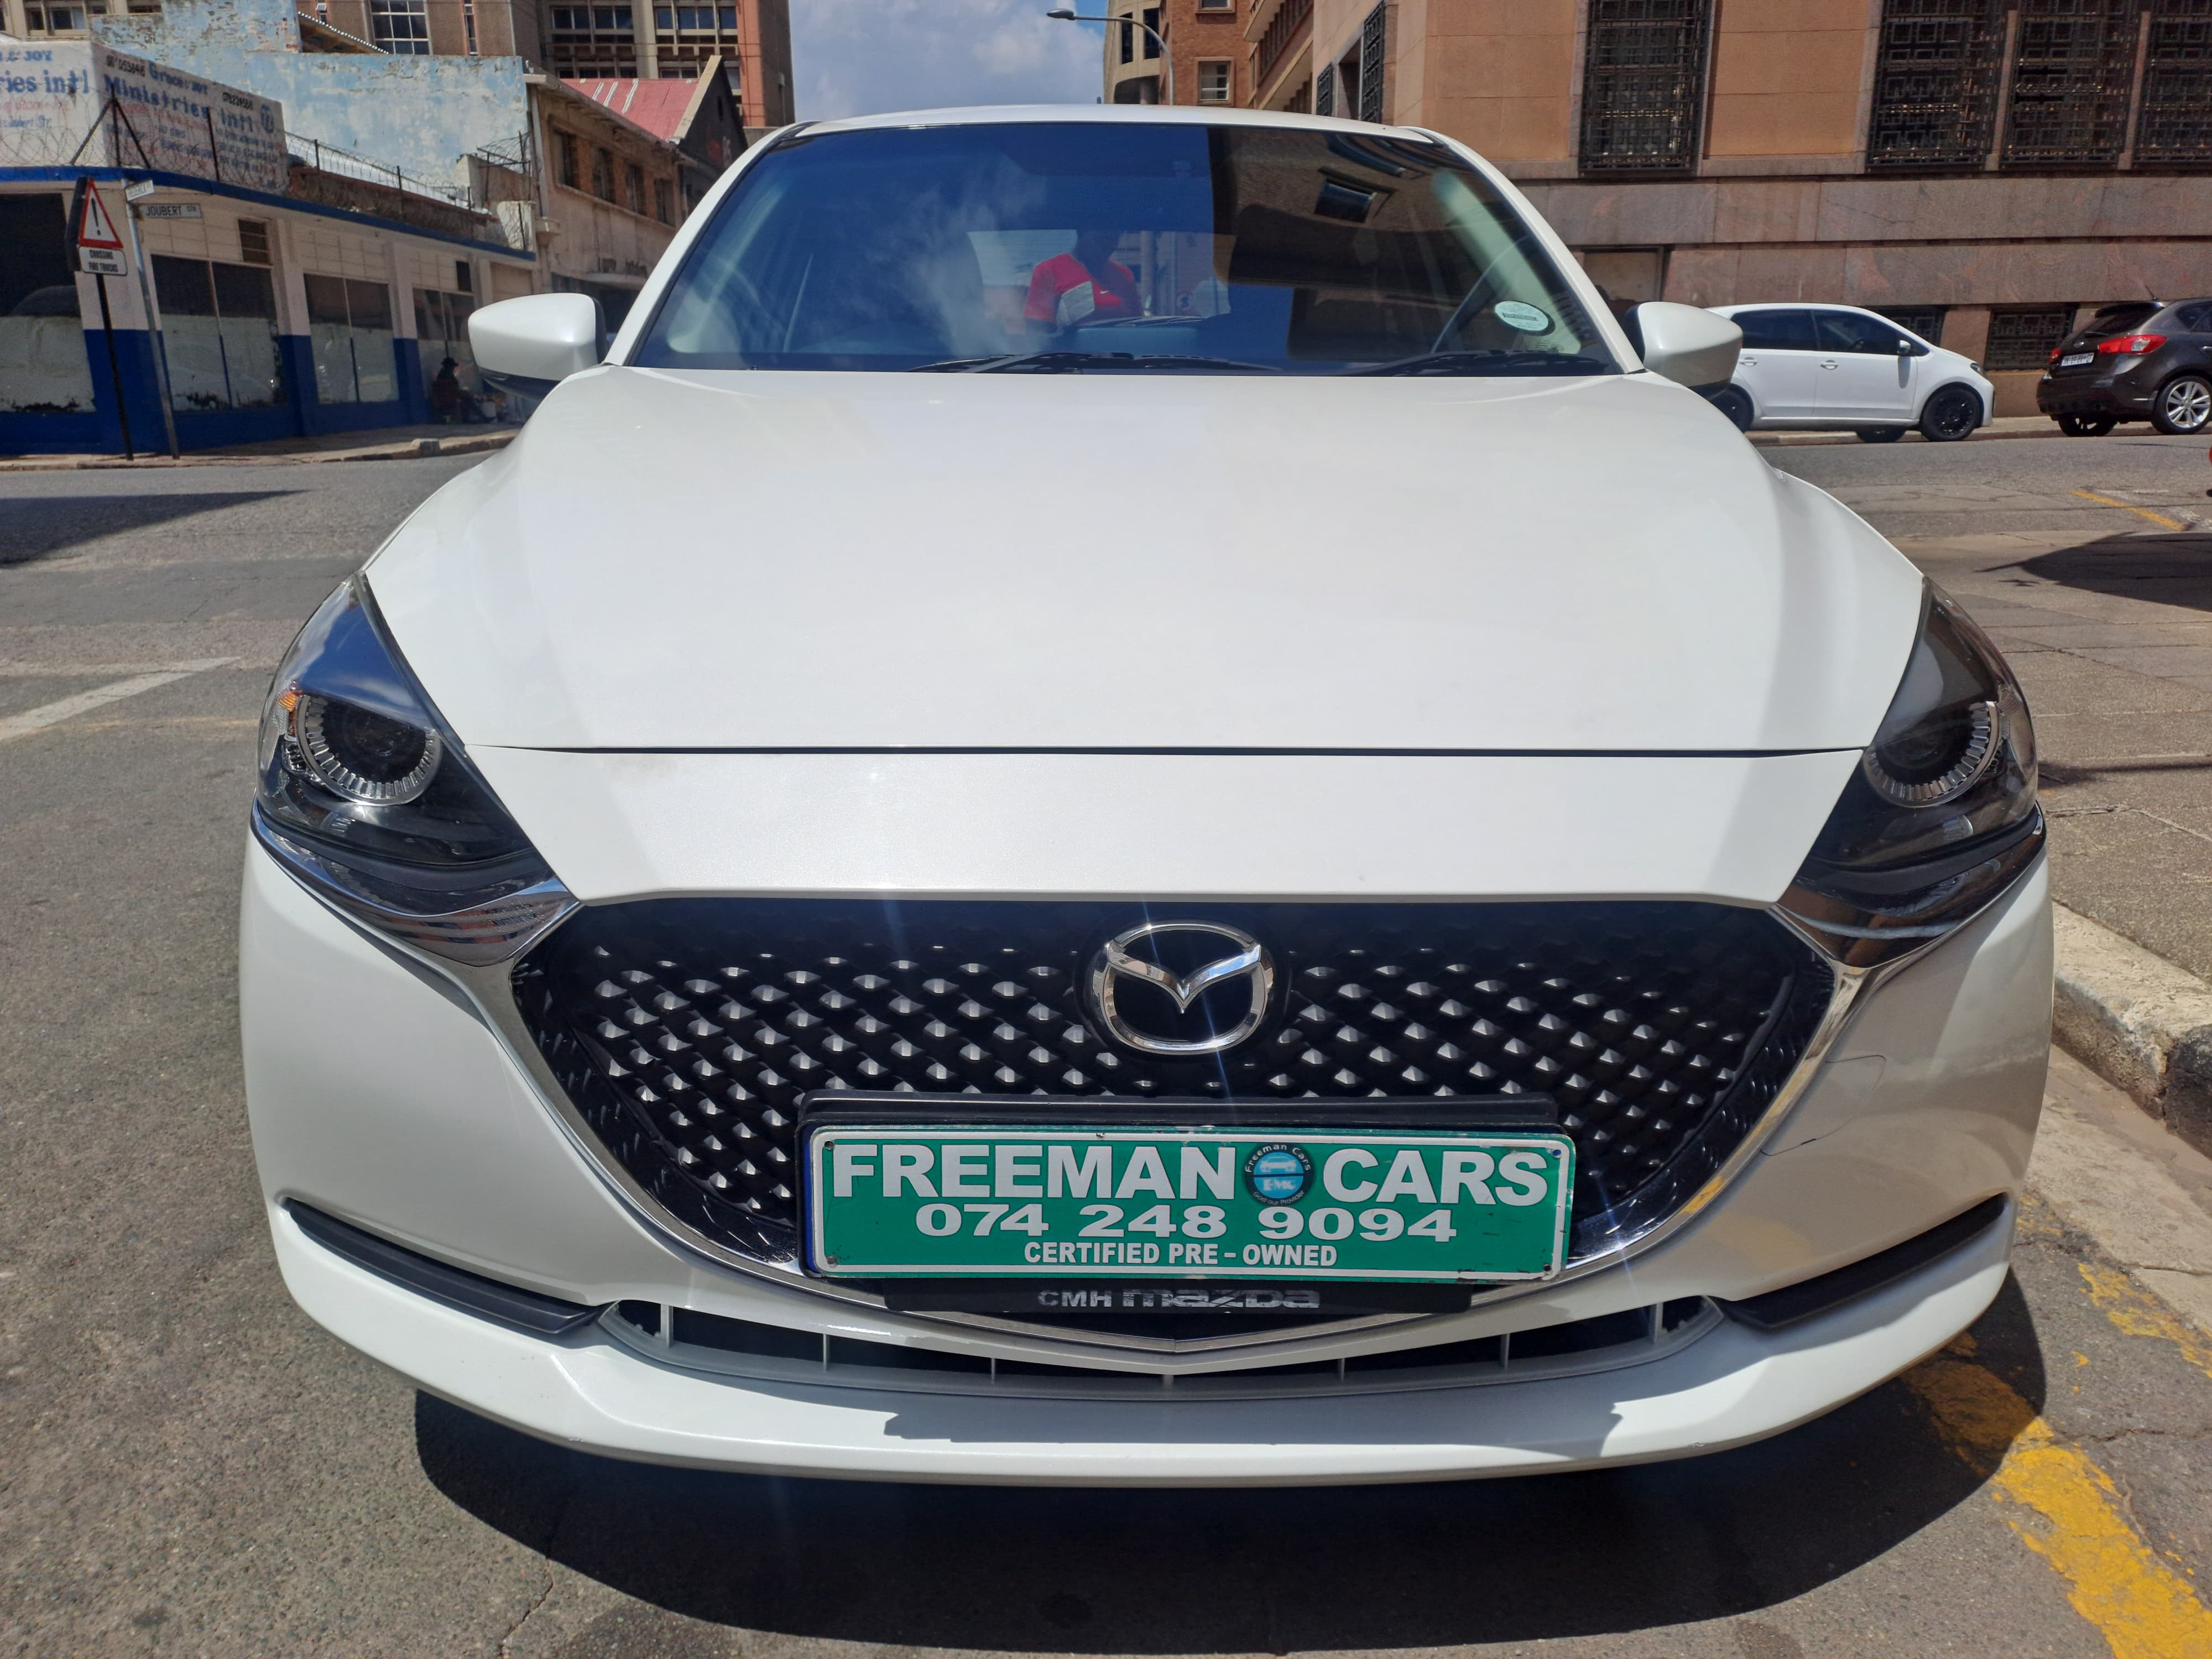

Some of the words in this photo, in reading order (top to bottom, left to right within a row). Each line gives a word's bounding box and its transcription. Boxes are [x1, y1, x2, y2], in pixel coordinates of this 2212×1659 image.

[24, 50, 53, 61] JOY
[103, 74, 208, 119] Ministries
[146, 206, 182, 216] JOUBERT
[1245, 1144, 1287, 1172] Freeman
[1292, 1147, 1311, 1171] Cars
[833, 1144, 1236, 1200] FREEMAN
[1323, 1148, 1549, 1206] CARS
[1253, 1191, 1267, 1202] God
[1280, 1191, 1305, 1204] Provider
[916, 1204, 1049, 1237] 074
[1078, 1204, 1227, 1239] 248
[1258, 1207, 1457, 1242] 9094
[1024, 1242, 1160, 1264] CERTIFIED
[1168, 1244, 1218, 1265] PRE
[1243, 1244, 1337, 1266] OWNED
[1038, 1290, 1112, 1308] CMH
